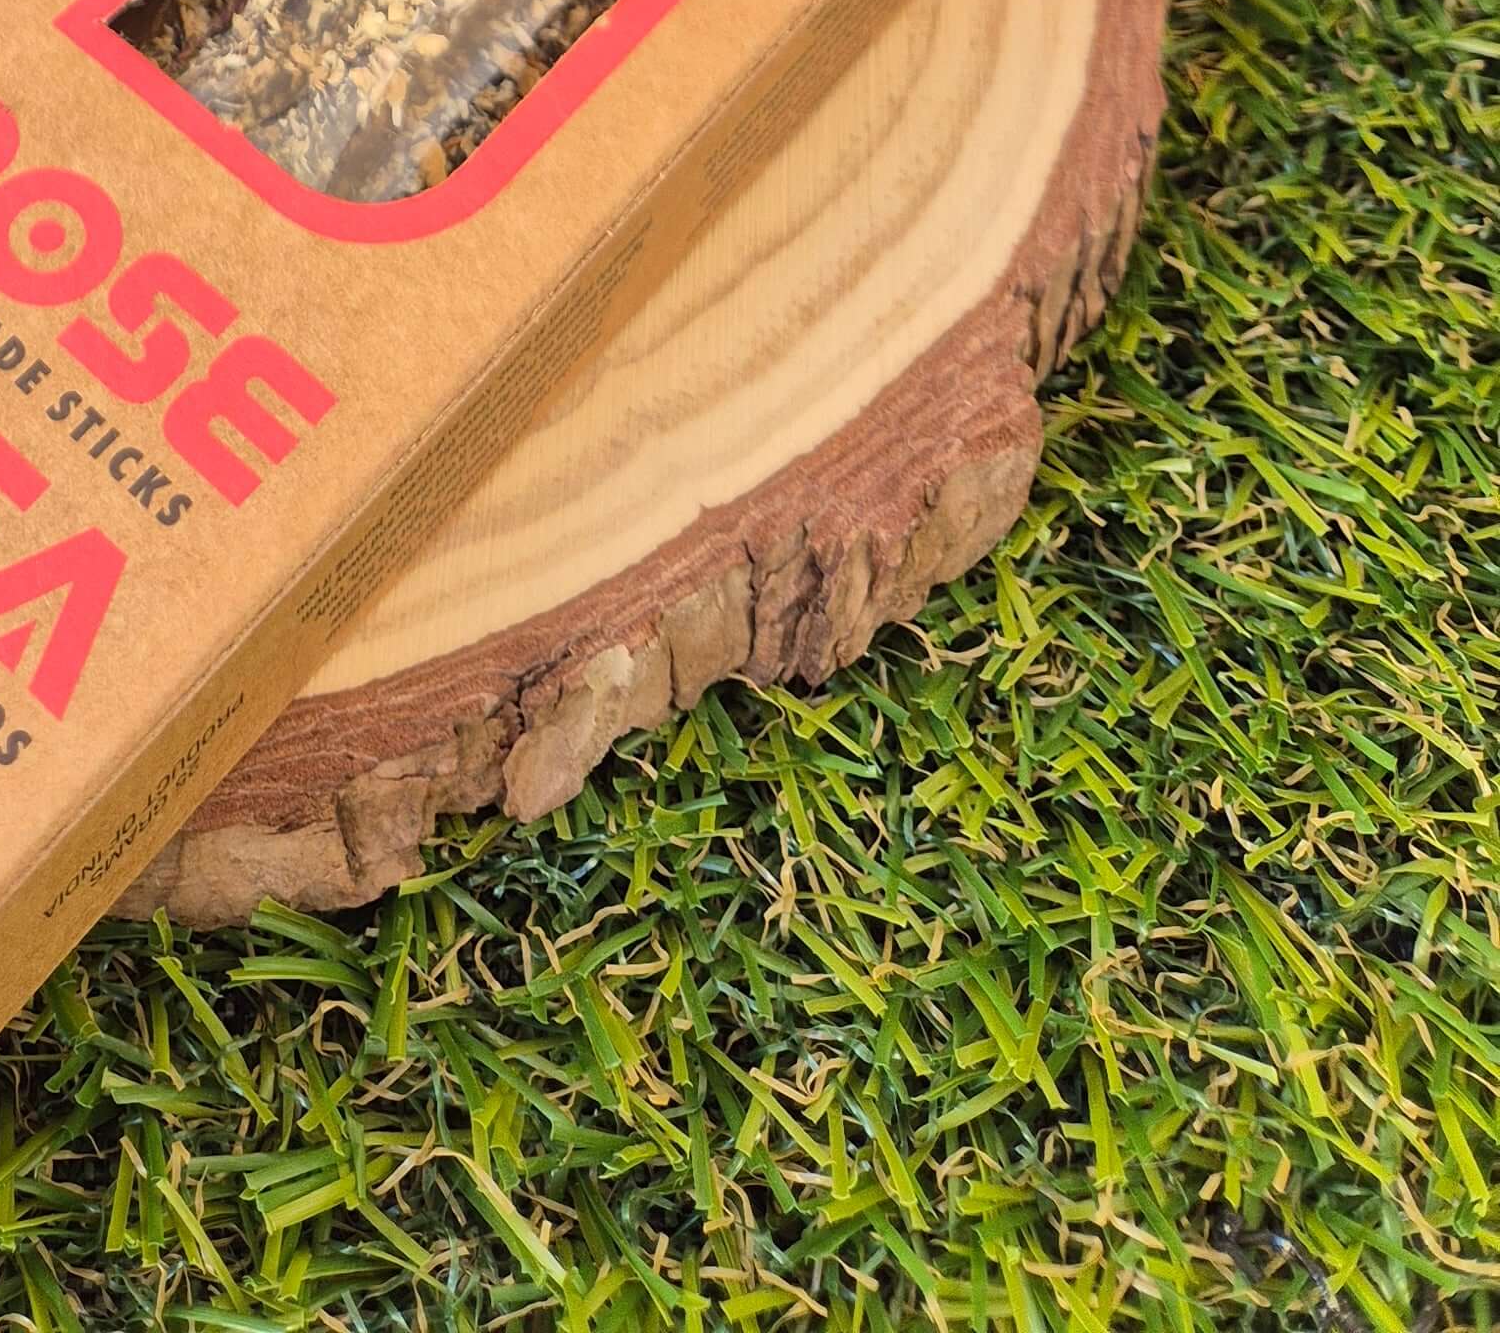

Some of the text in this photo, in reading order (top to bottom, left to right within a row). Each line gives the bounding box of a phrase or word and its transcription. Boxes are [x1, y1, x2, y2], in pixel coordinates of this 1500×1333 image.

[45, 390, 195, 529] STICKS
[43, 692, 244, 919] PRODUCT OF INDIA
[90, 794, 169, 887] GRAMS
